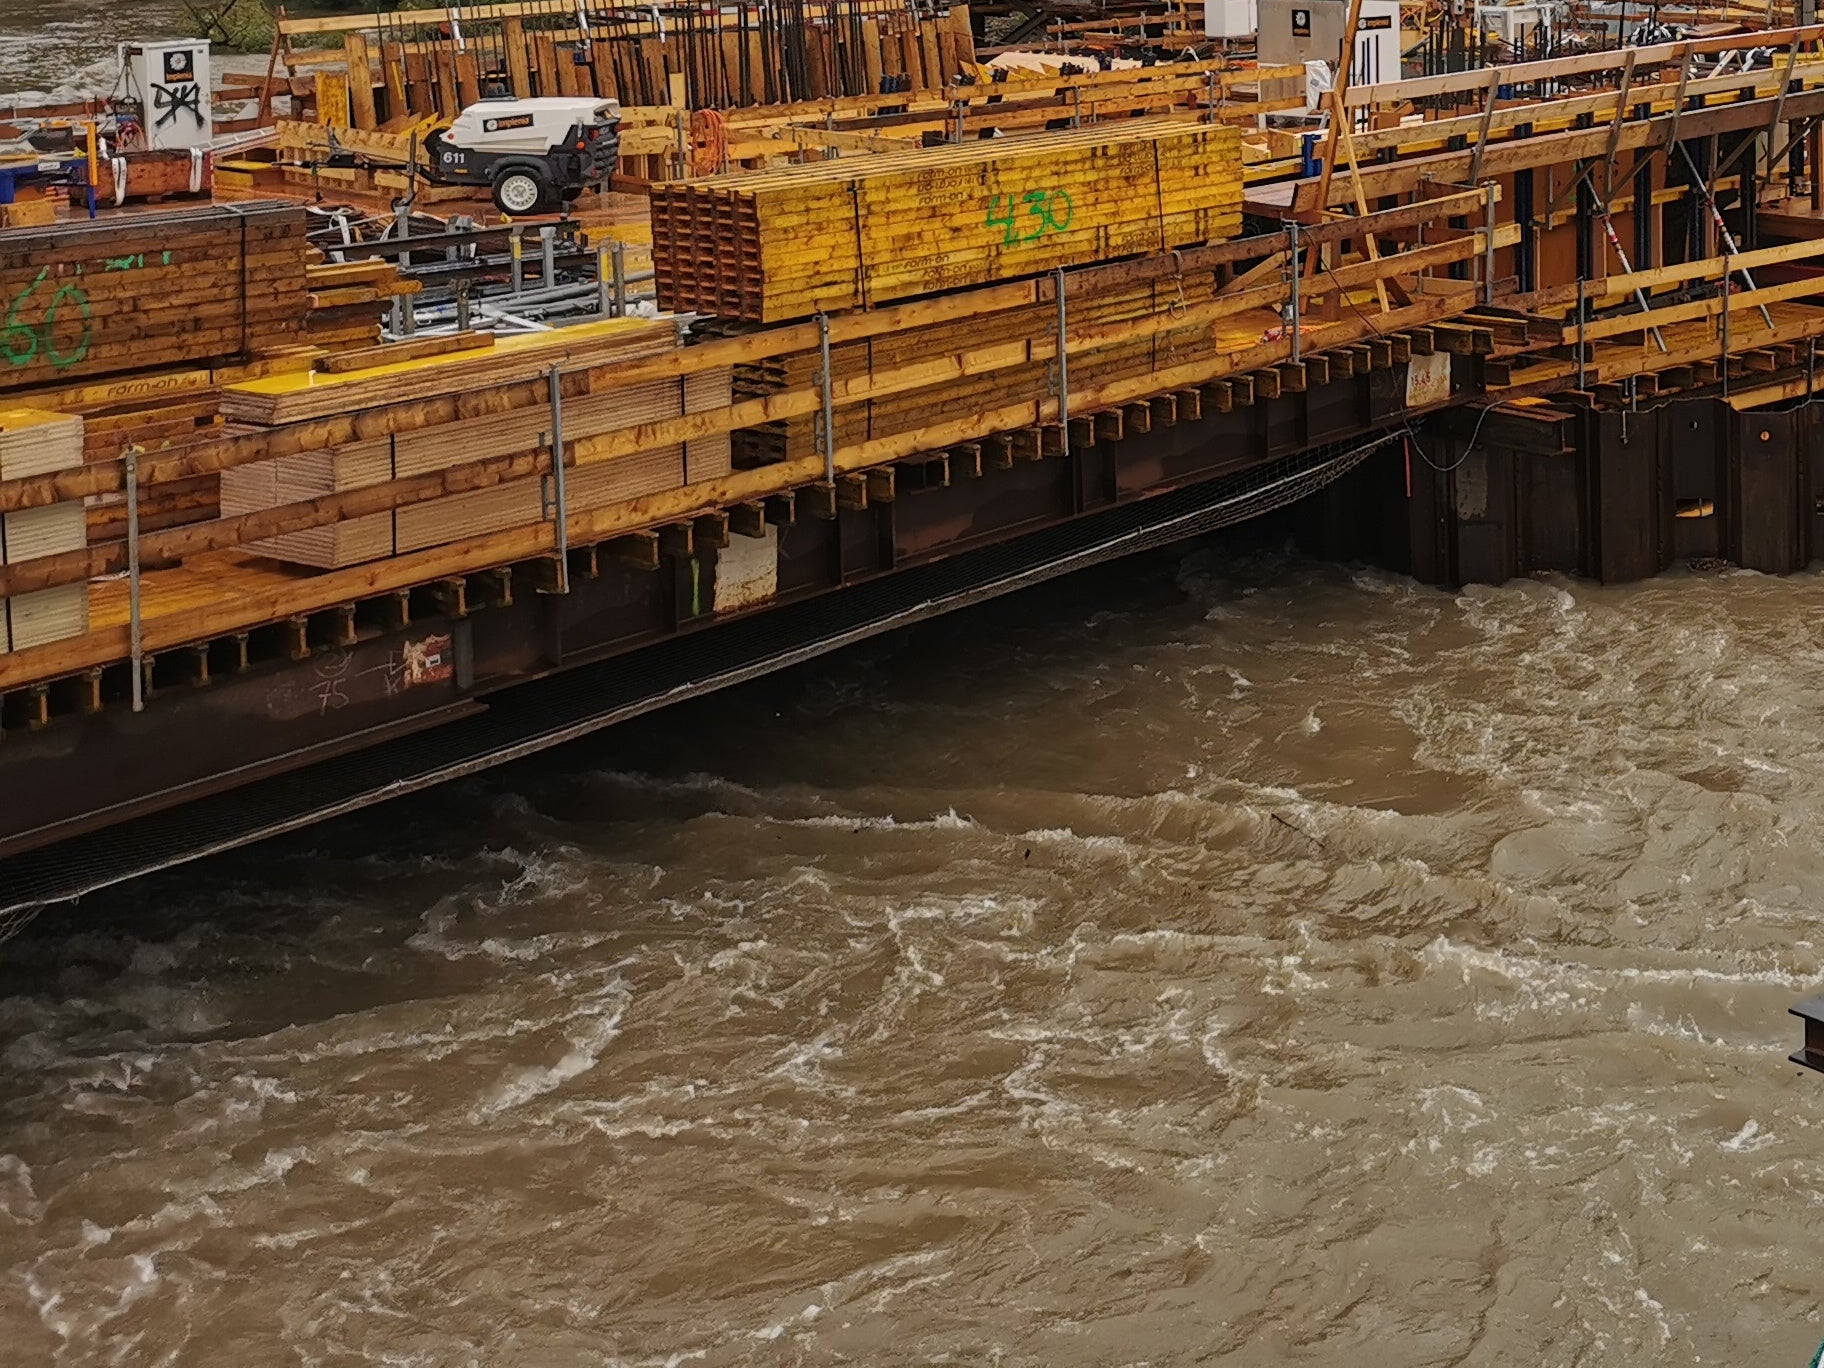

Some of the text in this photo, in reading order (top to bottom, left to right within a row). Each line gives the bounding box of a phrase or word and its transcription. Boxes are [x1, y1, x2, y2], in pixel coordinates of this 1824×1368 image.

[443, 152, 464, 164] 611
[986, 190, 1072, 246] 430
[0, 265, 91, 368] 60
